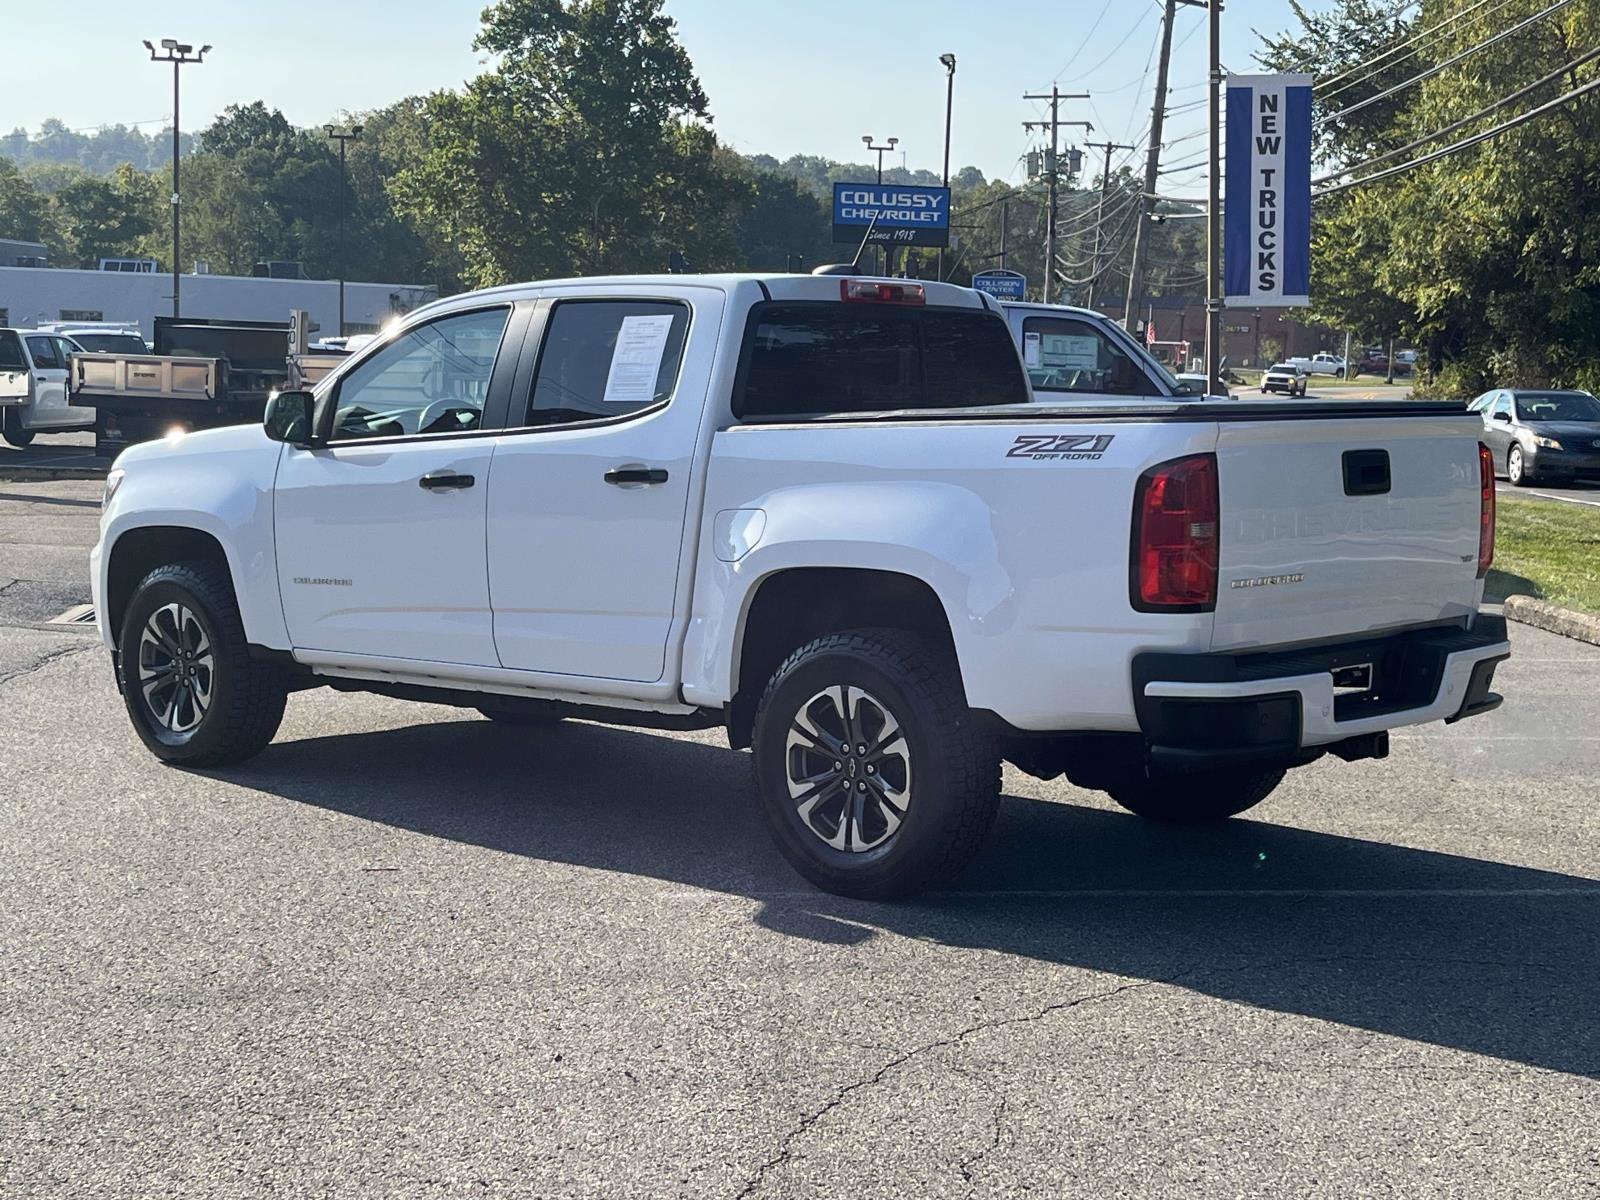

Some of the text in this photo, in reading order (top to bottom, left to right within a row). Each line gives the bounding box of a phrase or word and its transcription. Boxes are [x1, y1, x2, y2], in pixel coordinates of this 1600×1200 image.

[840, 191, 943, 208] COLUSSY
[1255, 94, 1282, 292] NEW TRUCKS
[841, 208, 942, 222] CHEVROLET
[893, 229, 916, 241] 1918
[976, 280, 1020, 288] COLLISION
[1032, 453, 1103, 461] OFF ROAD
